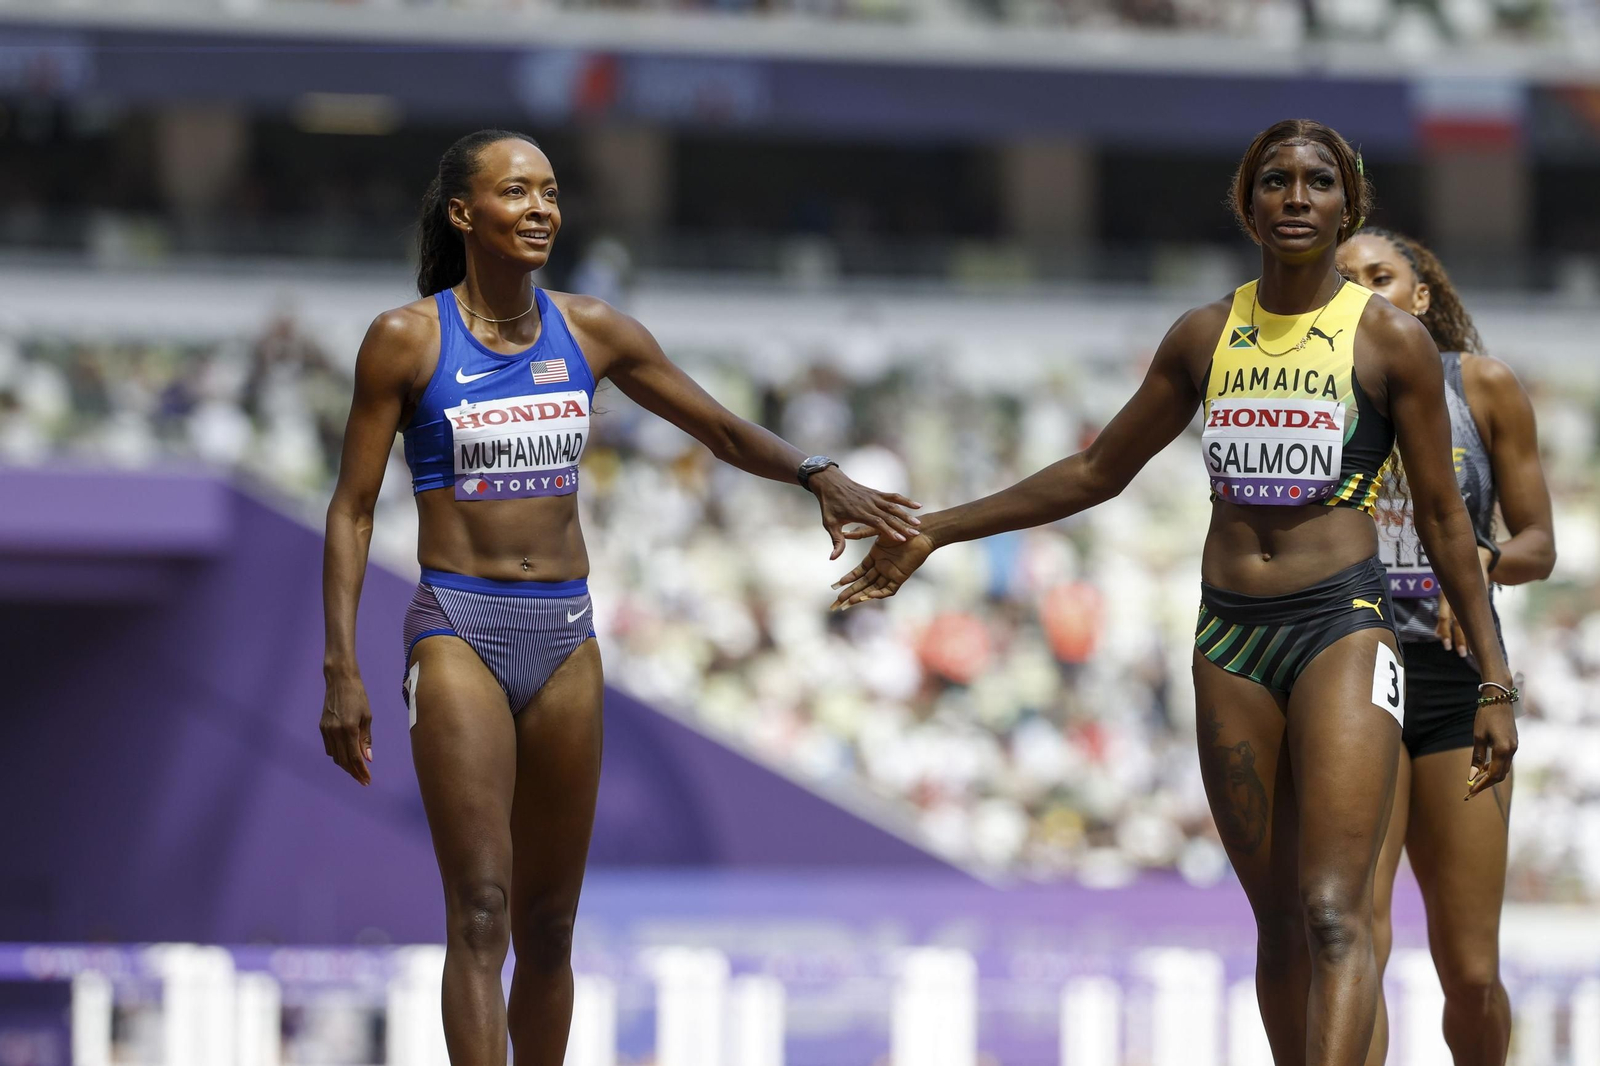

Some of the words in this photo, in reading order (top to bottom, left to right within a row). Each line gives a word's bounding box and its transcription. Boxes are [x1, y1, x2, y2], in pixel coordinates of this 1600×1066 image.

[1218, 367, 1338, 400] JAMAICA
[452, 400, 587, 430] HONDA
[1208, 408, 1341, 431] HONDA
[461, 433, 583, 470] MUHAMMAD
[1209, 442, 1333, 476] SALMON
[1387, 661, 1400, 708] 3
